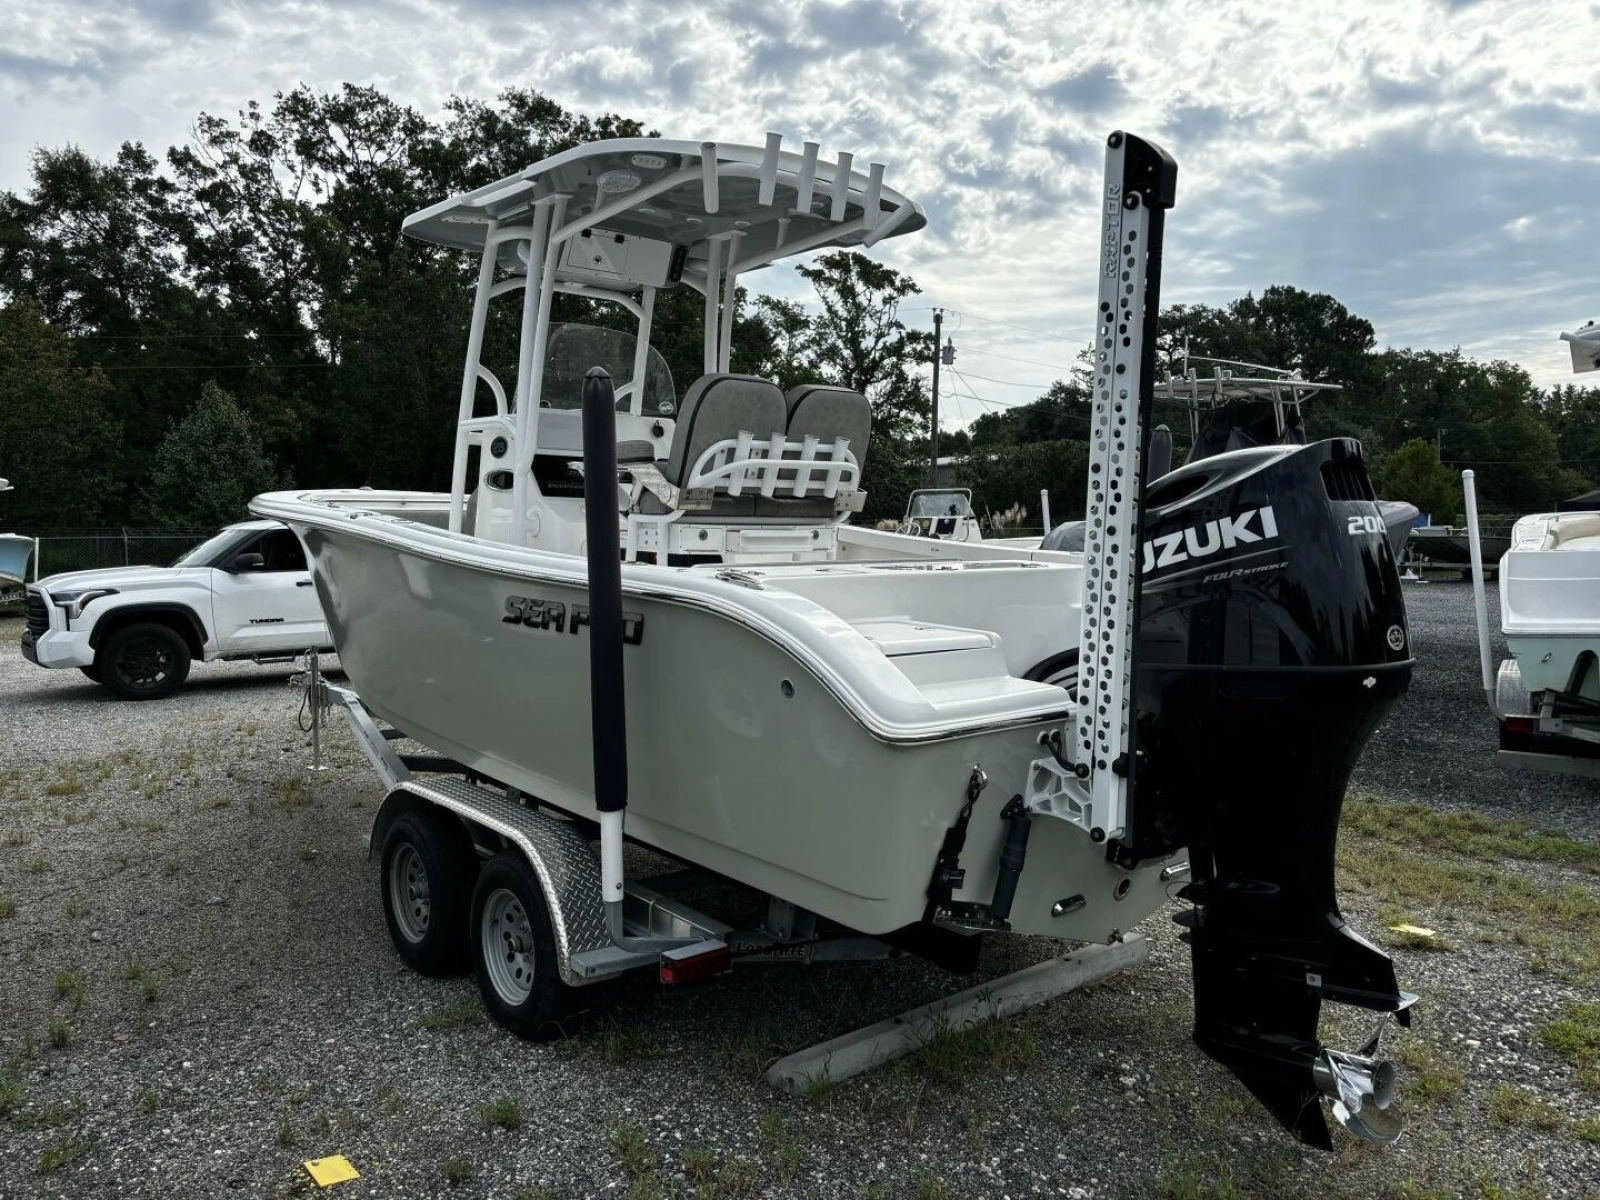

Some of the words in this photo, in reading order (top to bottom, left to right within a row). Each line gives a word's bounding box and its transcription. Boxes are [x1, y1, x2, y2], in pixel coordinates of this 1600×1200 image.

[1142, 505, 1279, 574] ZUKI
[1347, 515, 1387, 536] 200
[502, 595, 566, 633] SEA
[569, 603, 645, 646] PO
